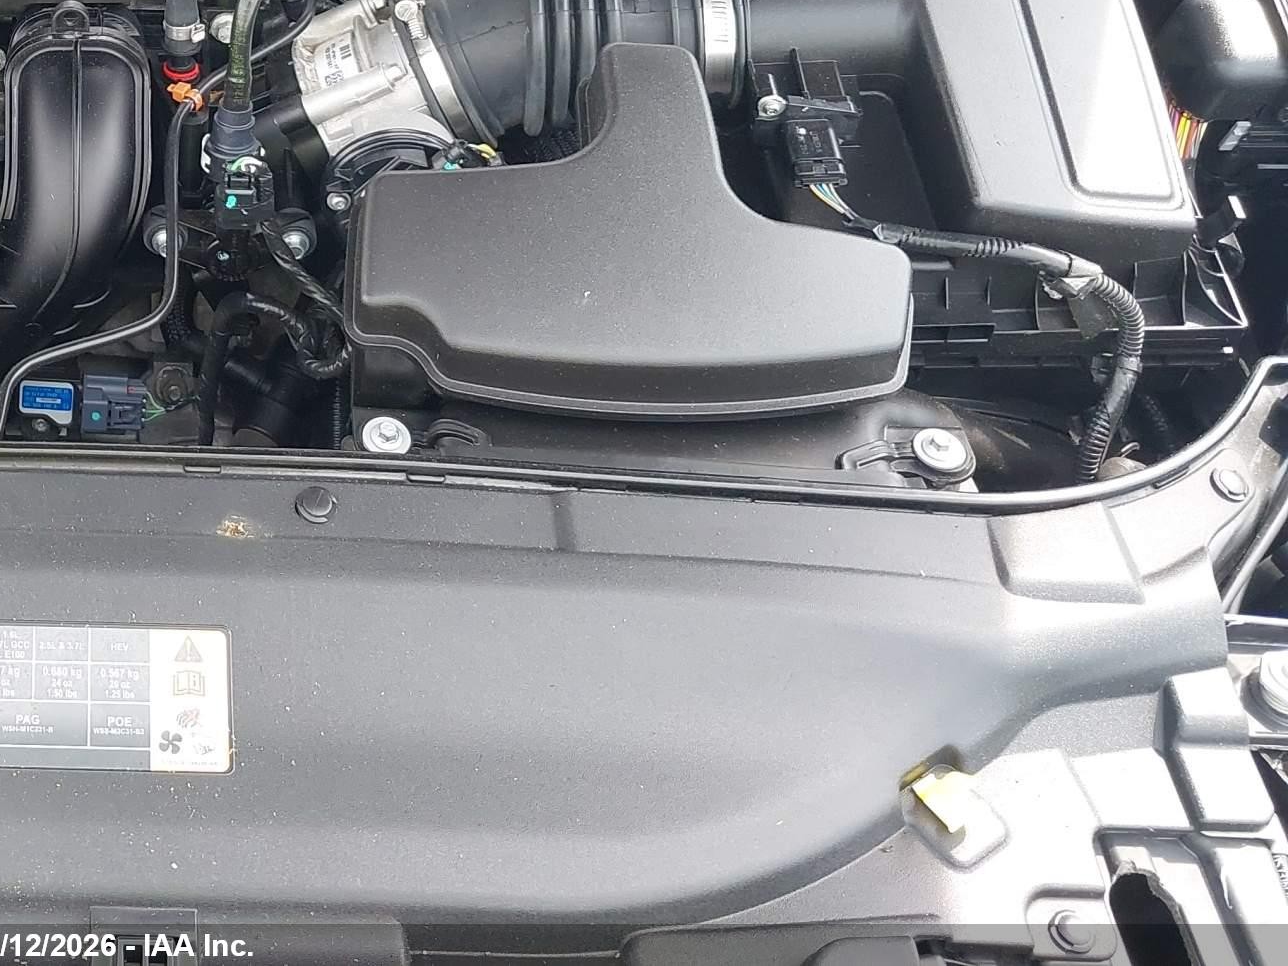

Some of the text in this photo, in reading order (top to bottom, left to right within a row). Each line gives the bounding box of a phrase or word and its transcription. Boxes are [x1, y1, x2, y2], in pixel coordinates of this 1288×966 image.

[110, 642, 129, 651] HEV
[4, 650, 26, 659] E100
[7, 665, 20, 678] kg
[70, 666, 82, 679] kg
[127, 669, 139, 680] kg
[63, 680, 72, 688] oz
[120, 681, 131, 689] oz
[2, 687, 15, 697] lbs
[65, 689, 78, 699] lbs
[122, 690, 135, 699] lbs
[15, 714, 40, 725] PAG
[107, 716, 132, 727] POE
